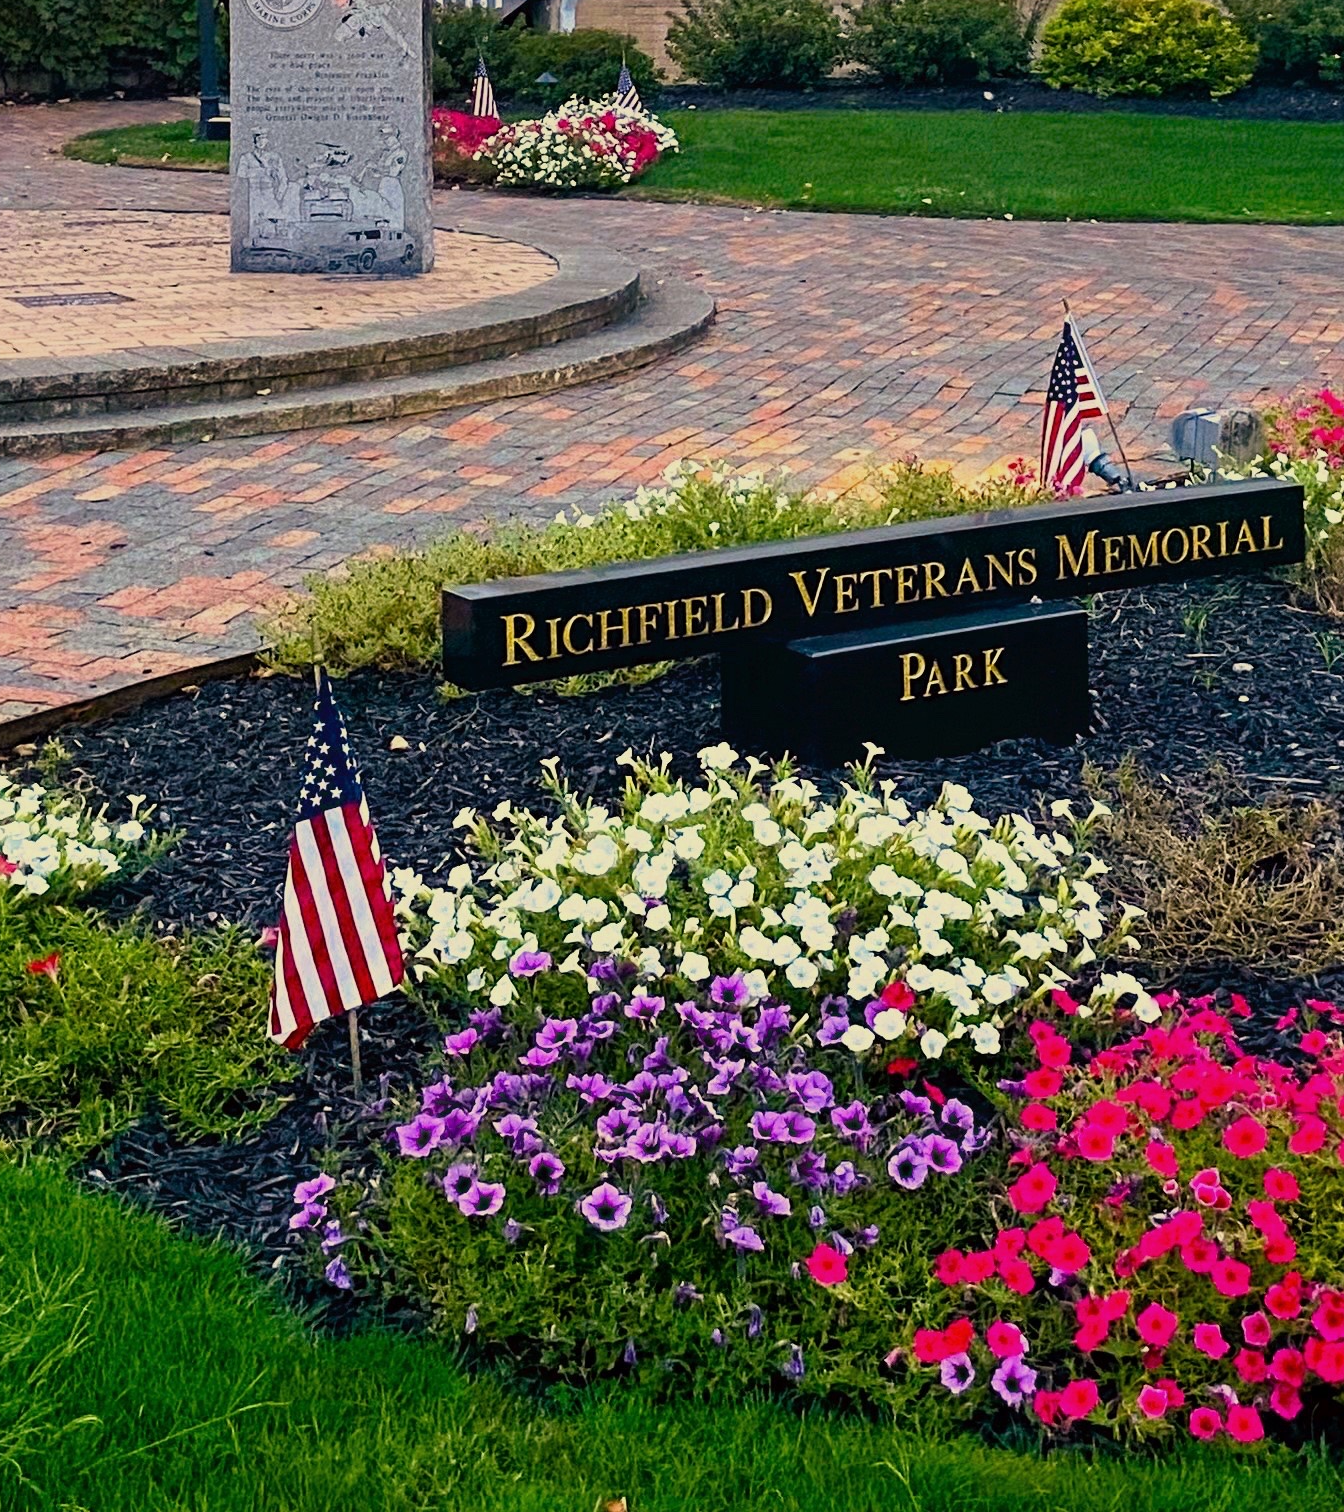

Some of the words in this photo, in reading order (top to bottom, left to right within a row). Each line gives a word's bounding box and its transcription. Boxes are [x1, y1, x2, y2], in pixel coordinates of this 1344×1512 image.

[252, 1, 287, 25] MARINE
[289, 1, 316, 23] CORPS
[500, 588, 773, 667] RICHFIELD
[788, 548, 1038, 617] VETERANS
[1055, 515, 1284, 580] MEMORIAL
[899, 647, 1008, 701] PARK
